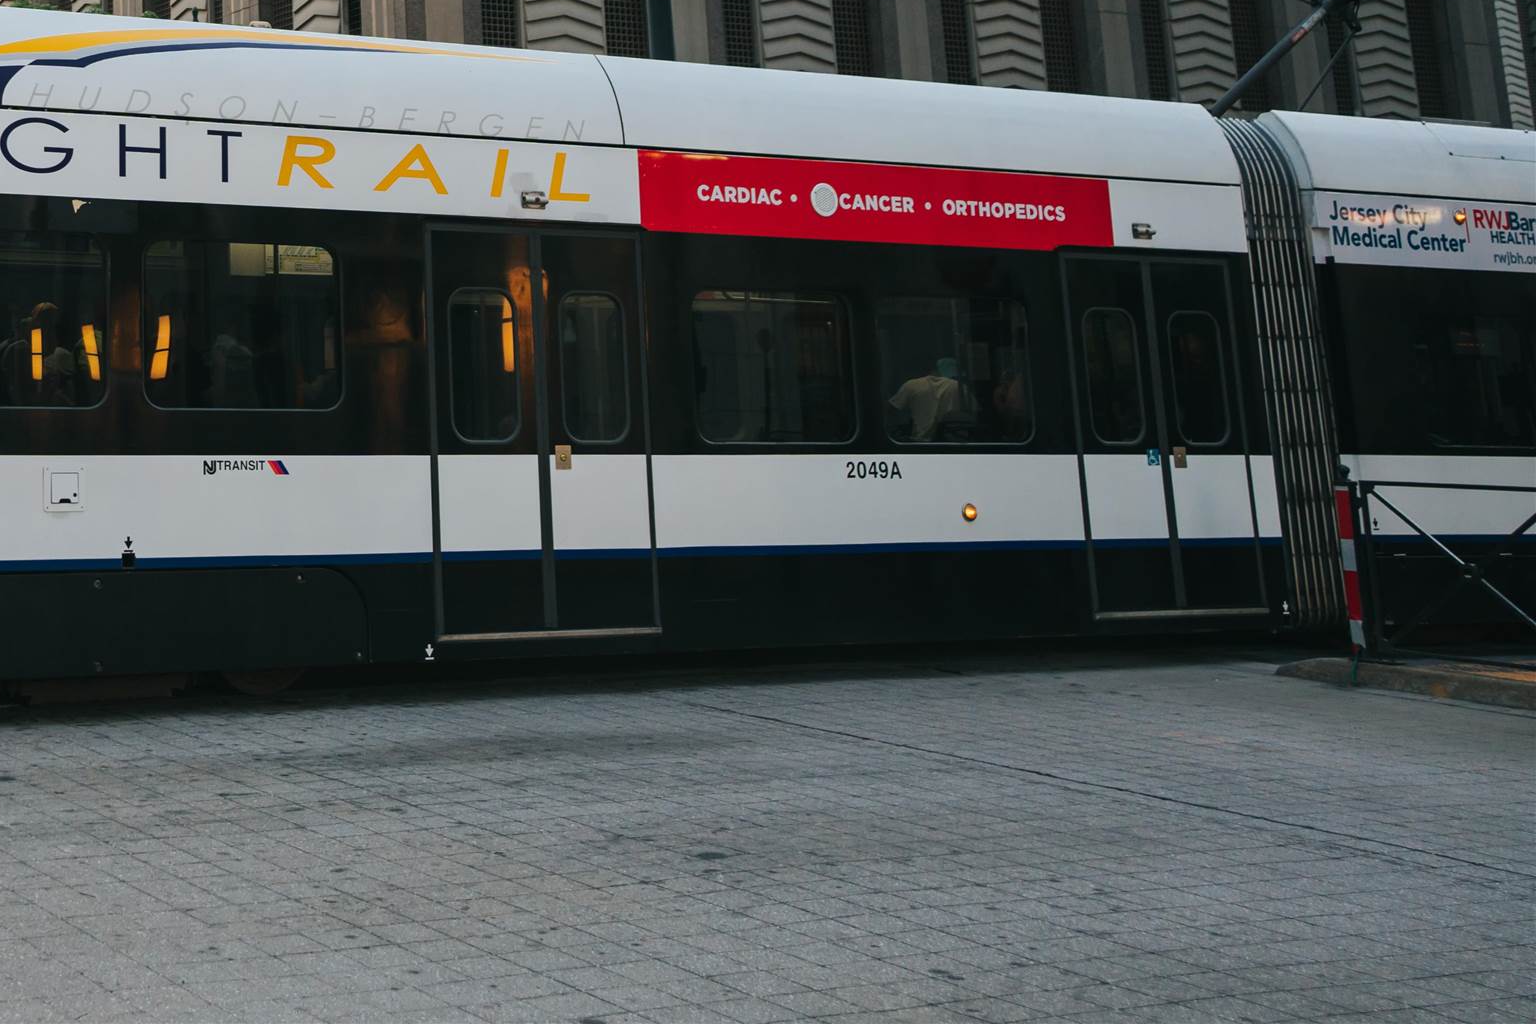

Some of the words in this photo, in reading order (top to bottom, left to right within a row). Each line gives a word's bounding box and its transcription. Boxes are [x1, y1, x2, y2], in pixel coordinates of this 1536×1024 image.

[696, 183, 783, 206] CARDIAC
[838, 192, 915, 215] CANCER
[941, 198, 1066, 223] ORTHOPEDICS
[1329, 199, 1388, 229] Jersey
[1392, 203, 1428, 231] City
[1332, 225, 1403, 250] Medical
[1407, 229, 1467, 253] Center
[1490, 230, 1536, 245] HEALTH
[846, 461, 902, 479] 2049A
